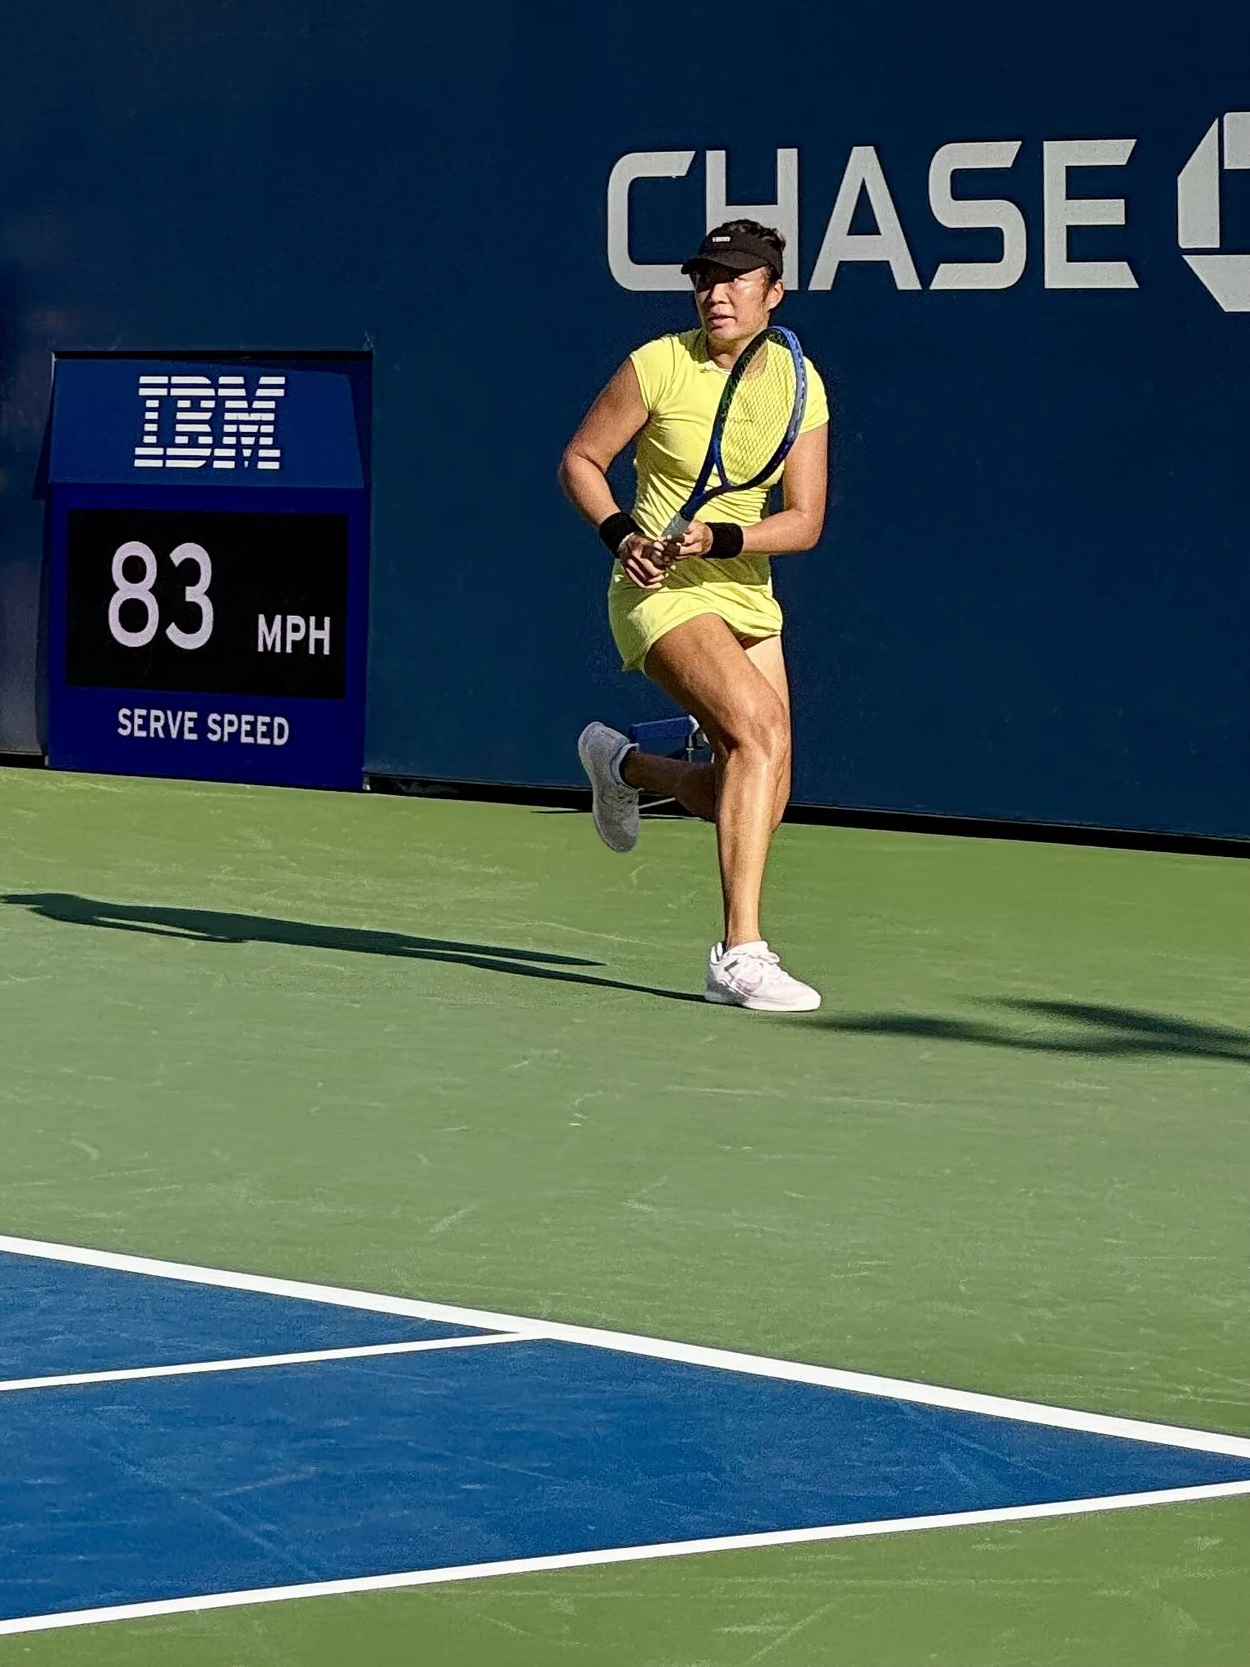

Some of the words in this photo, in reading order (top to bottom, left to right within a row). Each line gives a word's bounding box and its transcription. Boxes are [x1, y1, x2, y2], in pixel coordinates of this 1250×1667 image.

[606, 139, 1140, 292] CHASE
[134, 375, 286, 470] IBM
[108, 540, 214, 650] 83
[257, 613, 331, 655] MPH
[117, 707, 198, 741] SERVE
[206, 713, 290, 746] SPEED
